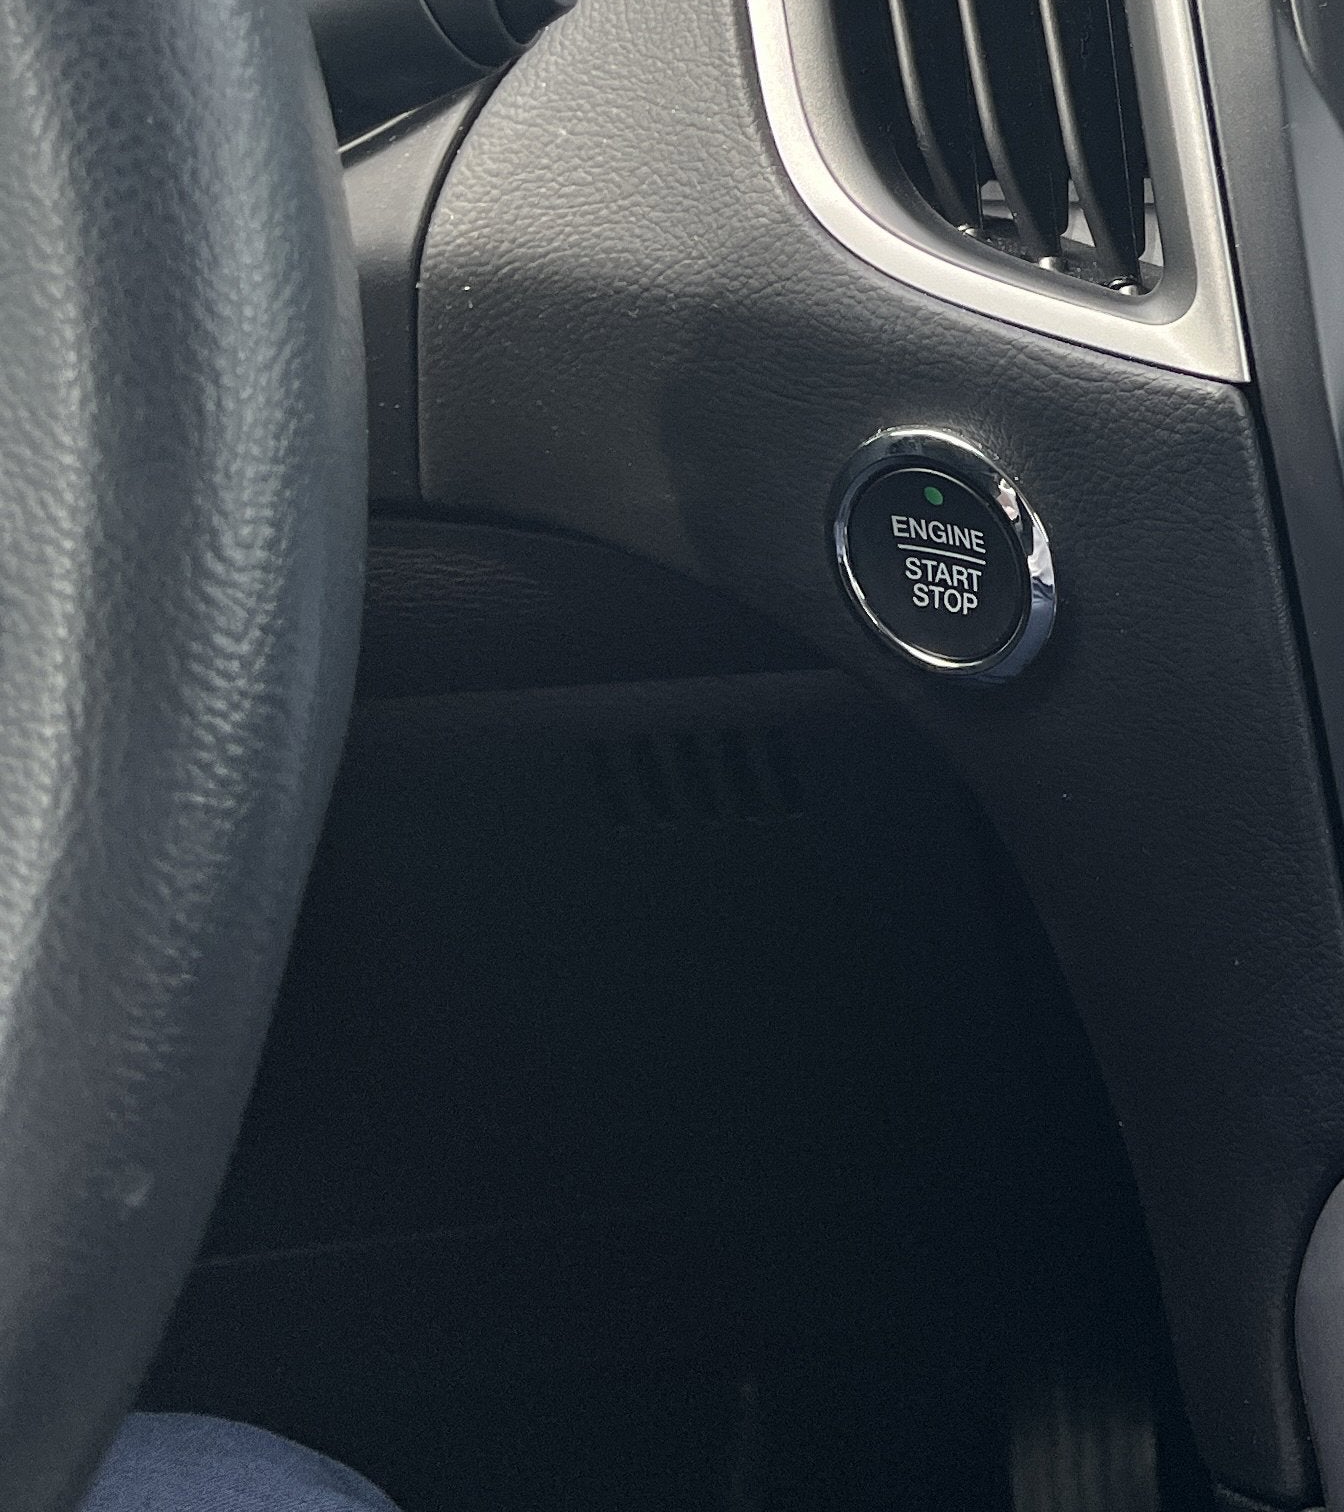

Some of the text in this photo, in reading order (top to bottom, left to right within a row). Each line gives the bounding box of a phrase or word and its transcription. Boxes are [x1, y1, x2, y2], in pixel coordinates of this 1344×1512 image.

[891, 514, 987, 554] ENGINE
[905, 556, 983, 592] START
[912, 582, 978, 615] STOP
